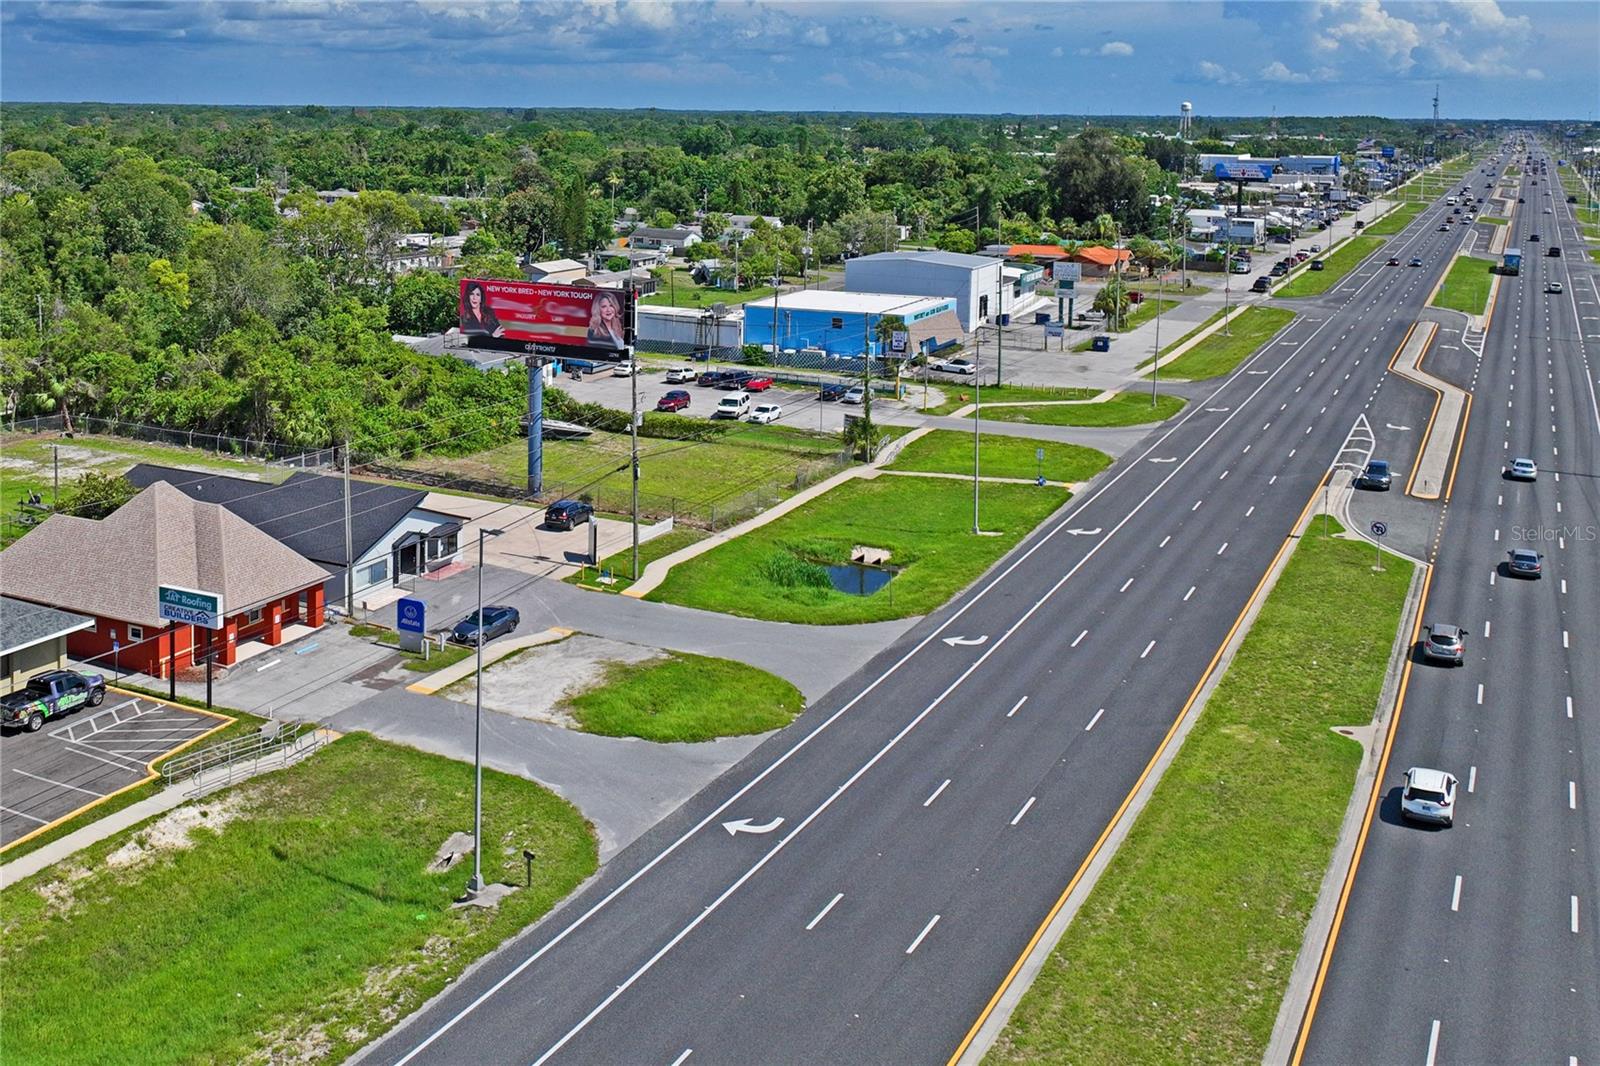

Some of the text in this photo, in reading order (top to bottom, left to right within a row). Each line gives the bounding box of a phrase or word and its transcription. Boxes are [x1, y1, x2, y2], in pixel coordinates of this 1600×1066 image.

[501, 286, 517, 294] YORK
[552, 290, 569, 298] YORK
[570, 291, 593, 300] TOUGH
[164, 604, 193, 614] CREATIVE
[181, 595, 212, 610] Roofing
[164, 609, 209, 624] BUILDERS
